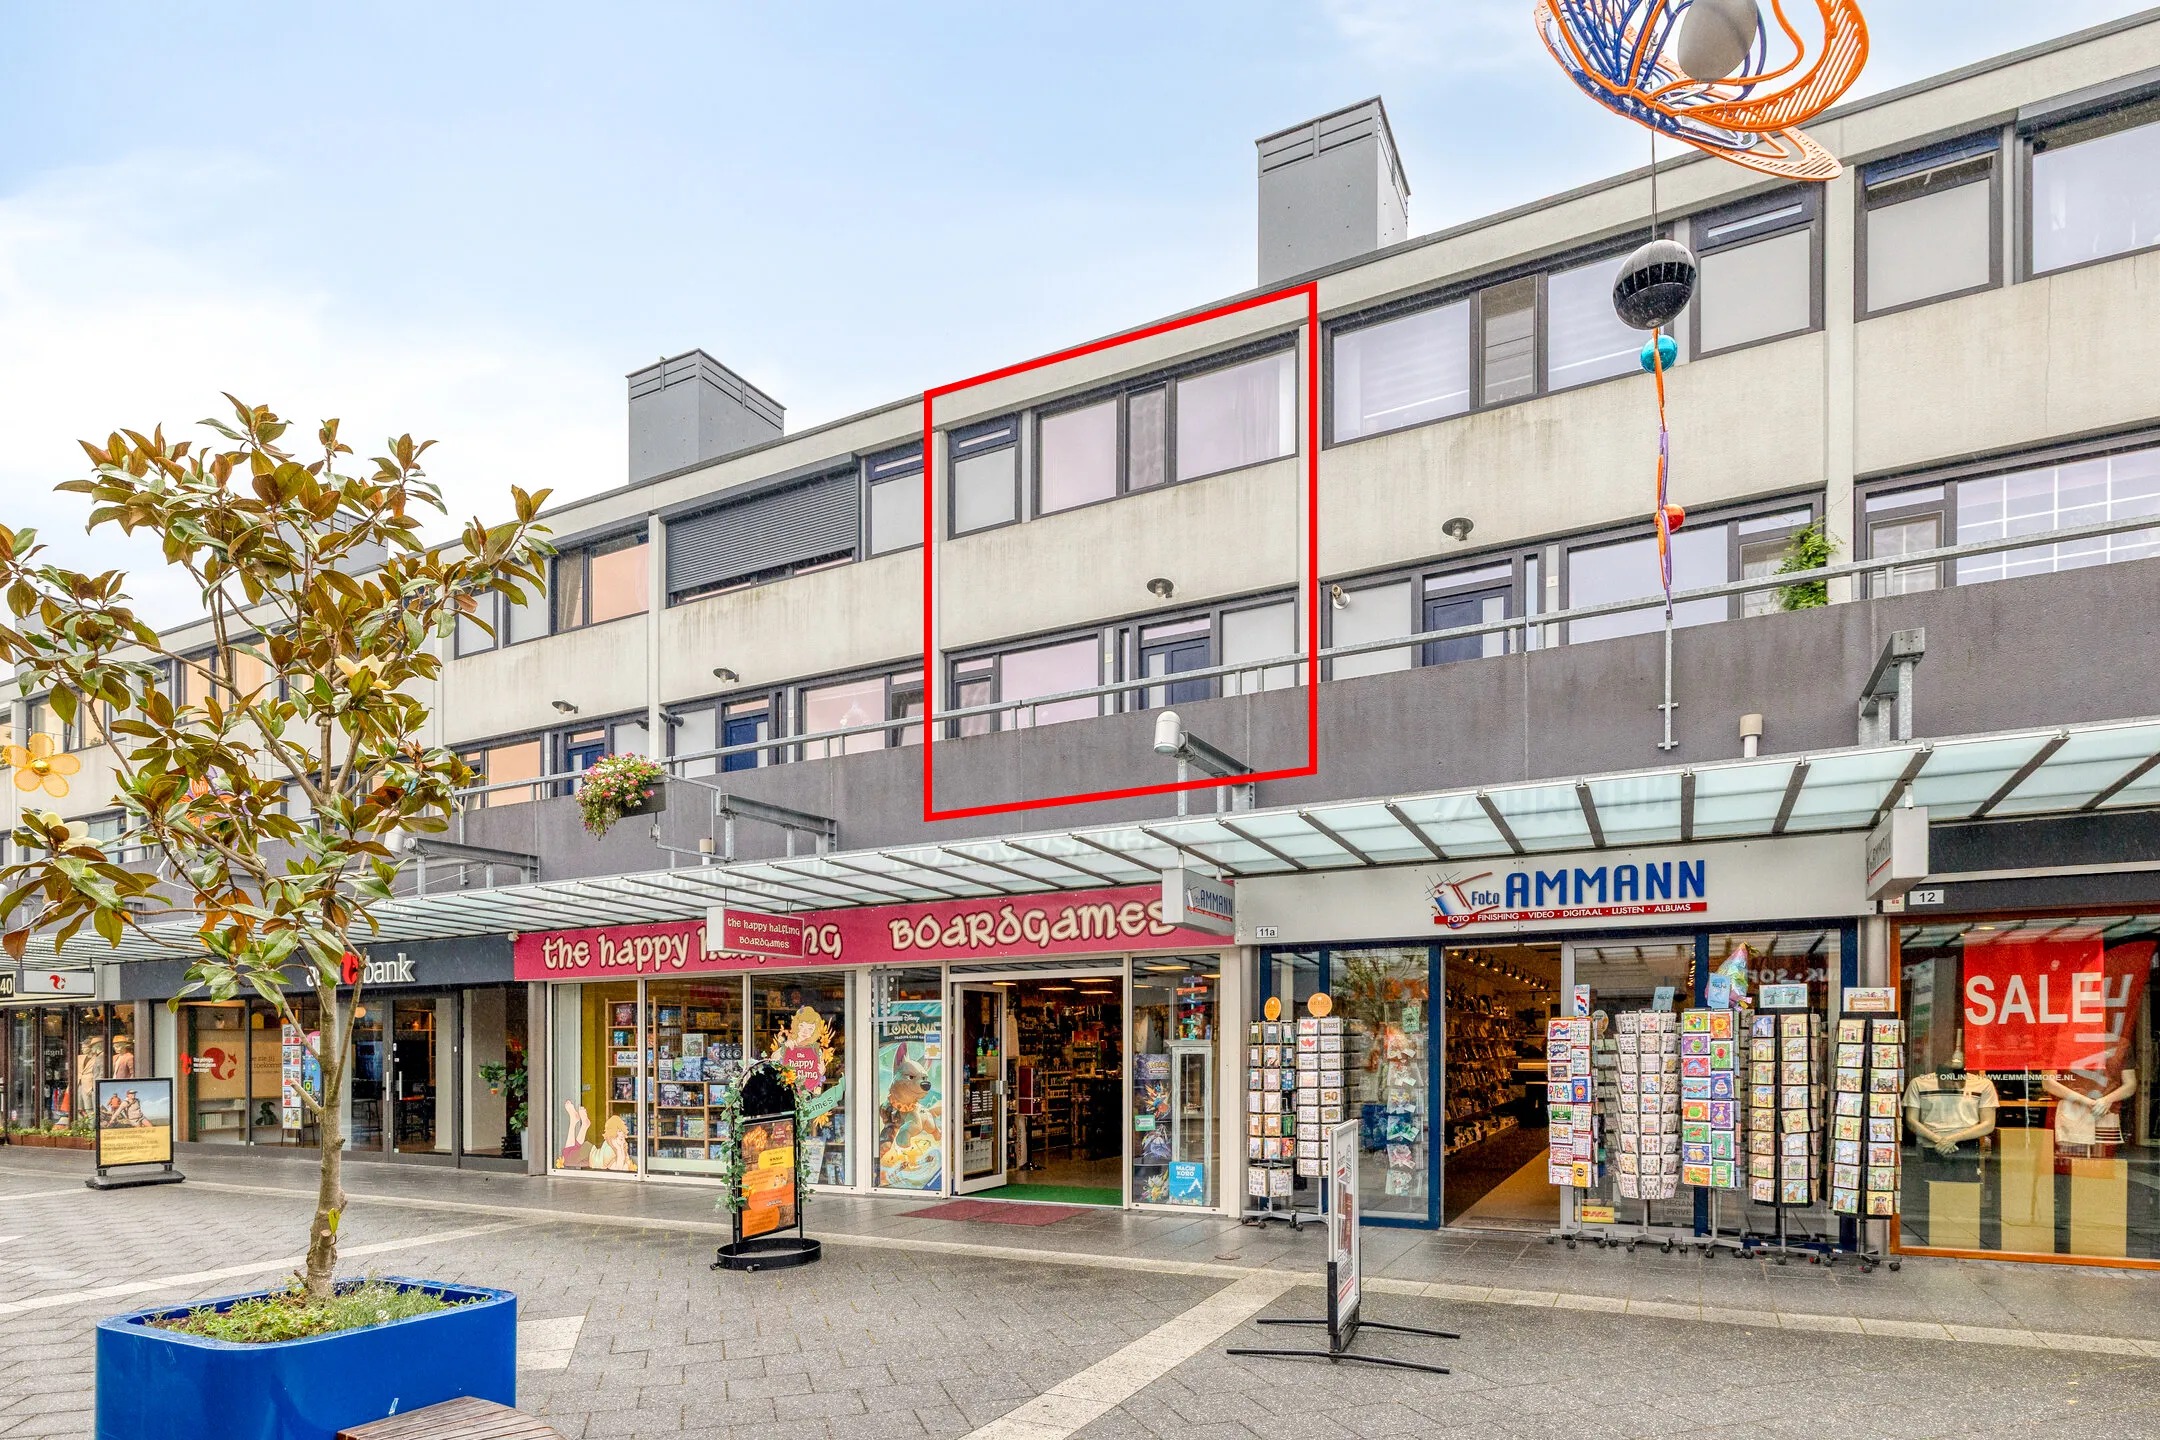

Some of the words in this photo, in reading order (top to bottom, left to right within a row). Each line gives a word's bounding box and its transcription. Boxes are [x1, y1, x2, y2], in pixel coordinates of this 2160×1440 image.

[1471, 891, 1500, 906] Foto
[1505, 860, 1705, 908] AMMANN
[1200, 889, 1233, 917] AMMANN
[1920, 892, 1935, 902] 12
[1447, 914, 1470, 923] FOTO
[1477, 912, 1520, 921] FINISHING
[1528, 910, 1555, 919] VIDEO
[1563, 908, 1603, 917] DIGITAAL
[1611, 906, 1645, 915] LIJSTEN
[1654, 904, 1691, 913] ALBUMS
[726, 917, 741, 927] the
[744, 920, 767, 932] happy
[769, 923, 800, 936] halfling
[1260, 928, 1275, 936] 11a
[542, 936, 591, 969] the
[597, 932, 691, 972] happy
[1965, 972, 2103, 1025] SALE
[789, 1059, 814, 1069] happy
[808, 1097, 833, 1112] ames
[1324, 1091, 1338, 1101] 50
